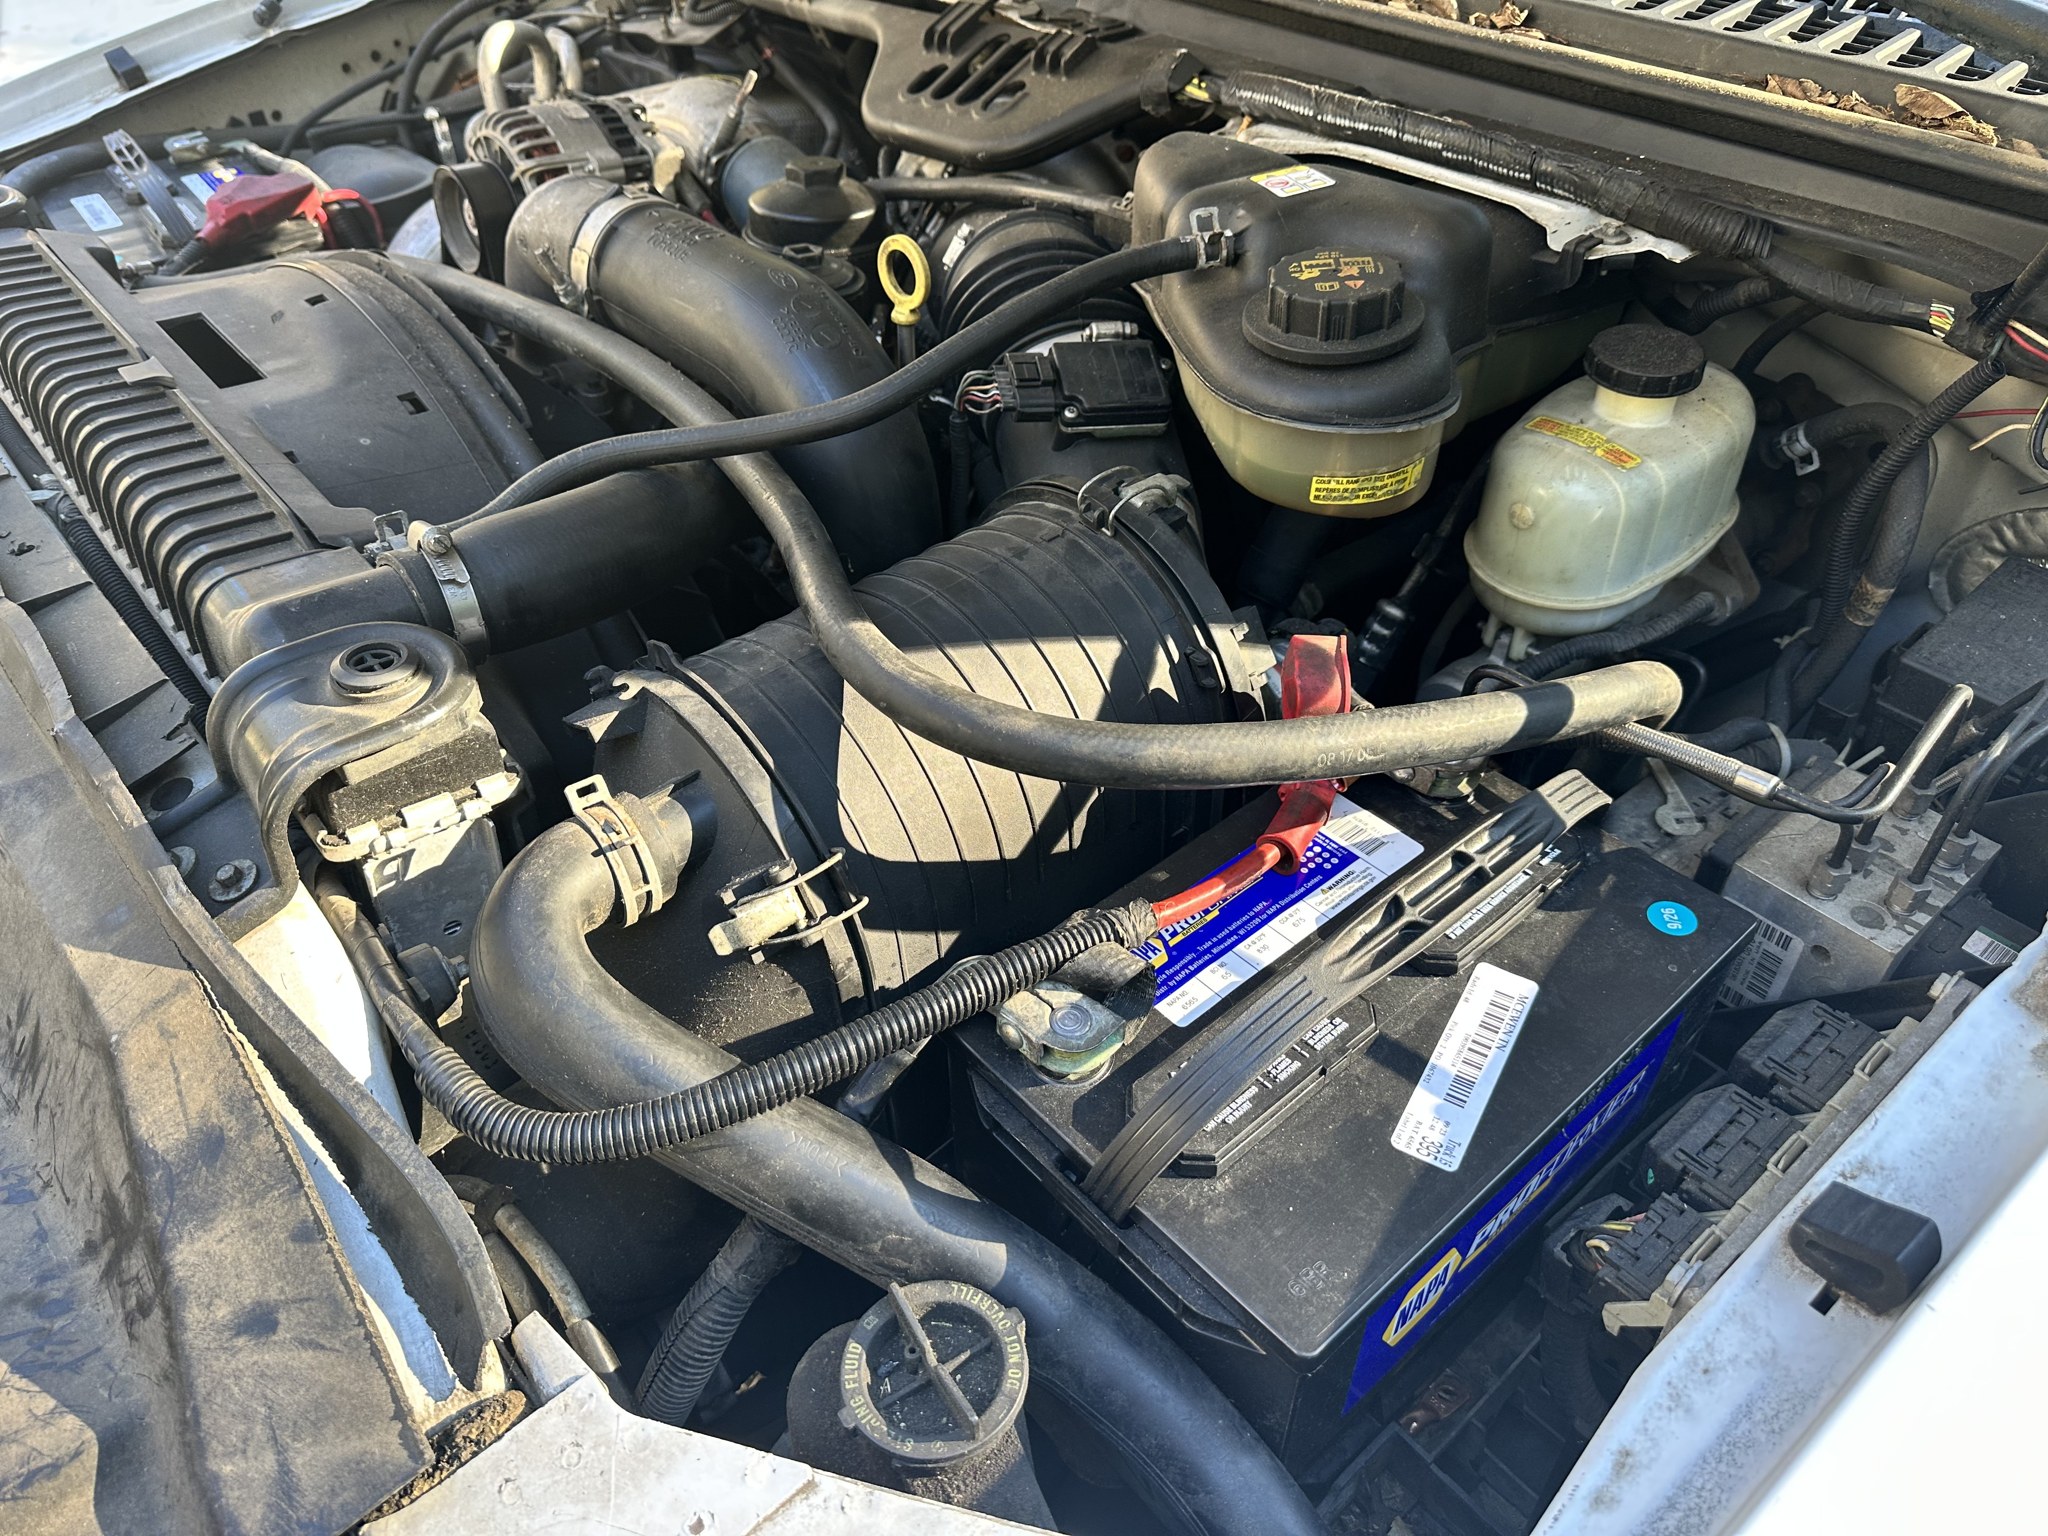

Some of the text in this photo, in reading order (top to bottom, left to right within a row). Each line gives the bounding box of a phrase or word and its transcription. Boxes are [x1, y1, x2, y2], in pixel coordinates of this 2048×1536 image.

[1326, 869, 1355, 891] WARNING:
[1167, 978, 1177, 988] by
[1175, 968, 1189, 981] NAPA
[1188, 951, 1213, 971] Batteries,
[1212, 932, 1239, 954] Milwaukee,
[1237, 927, 1246, 936] WI
[1245, 917, 1260, 930] 53209
[1258, 911, 1268, 921] for
[1266, 903, 1280, 915] NAPA
[1279, 885, 1305, 906] Distribution
[1304, 873, 1322, 888] Centers
[1182, 917, 1206, 936] BATTERIES
[1210, 935, 1218, 943] in
[1216, 927, 1229, 938] used
[1227, 913, 1249, 931] batteries
[1247, 909, 1254, 917] to
[1278, 914, 1290, 925] CCA
[1292, 916, 1305, 927] 675
[1257, 943, 1268, 954] 830
[1220, 970, 1232, 981] 65
[1167, 995, 1180, 1006] NAPA
[1181, 996, 1197, 1010] 6565
[1306, 1021, 1335, 1046] BLINDNESS
[1493, 992, 1529, 1052] MCEWEN TN
[1270, 1056, 1293, 1076] FLAMES
[1202, 1083, 1259, 1132] CAN CAUSE BLINDNESS
[1223, 1099, 1253, 1125] OR INJURY
[1414, 1134, 1444, 1162] 395
[1437, 1137, 1461, 1168] Truck 15
[1394, 1263, 1452, 1336] NAPA
[950, 1283, 1023, 1391] DO NOT OVERFILL
[843, 1341, 863, 1390] FLUID
